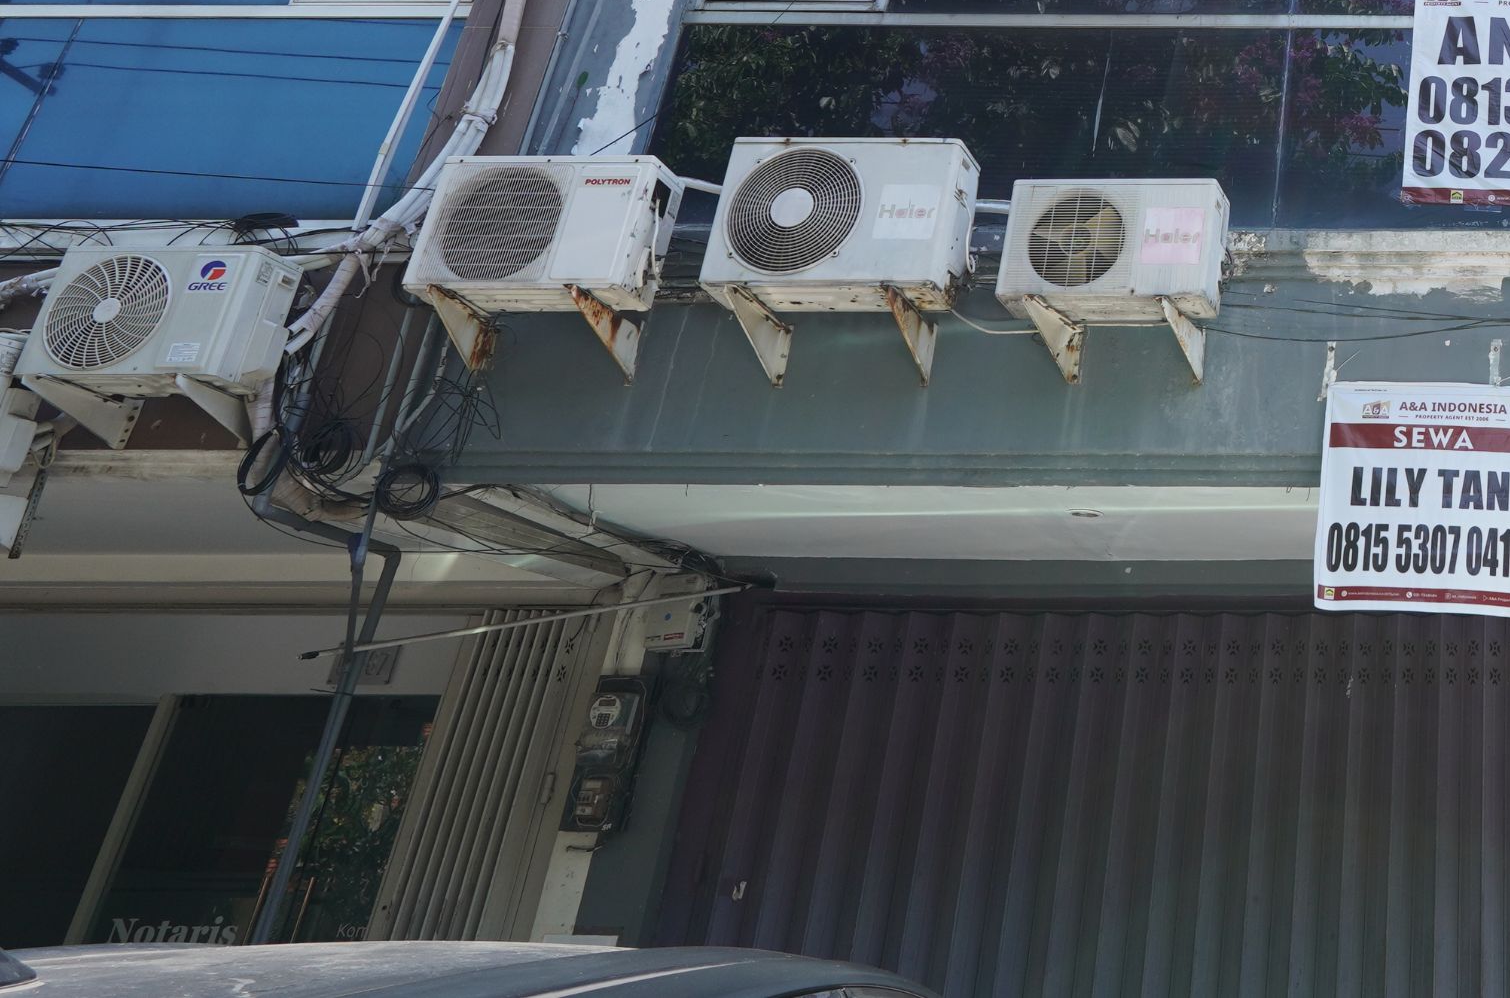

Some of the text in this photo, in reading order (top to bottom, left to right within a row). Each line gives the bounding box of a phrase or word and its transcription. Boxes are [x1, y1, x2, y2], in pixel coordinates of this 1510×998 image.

[878, 204, 935, 219] Haier
[1144, 228, 1201, 244] Haier
[187, 281, 228, 291] GREE
[1400, 401, 1508, 414] A&A INDONESIA
[1393, 426, 1474, 450] SEWA
[1350, 466, 1510, 511] LILY TAN
[1326, 522, 1390, 573] 0815
[1395, 523, 1461, 575] 5307
[107, 916, 239, 945] Notaris
